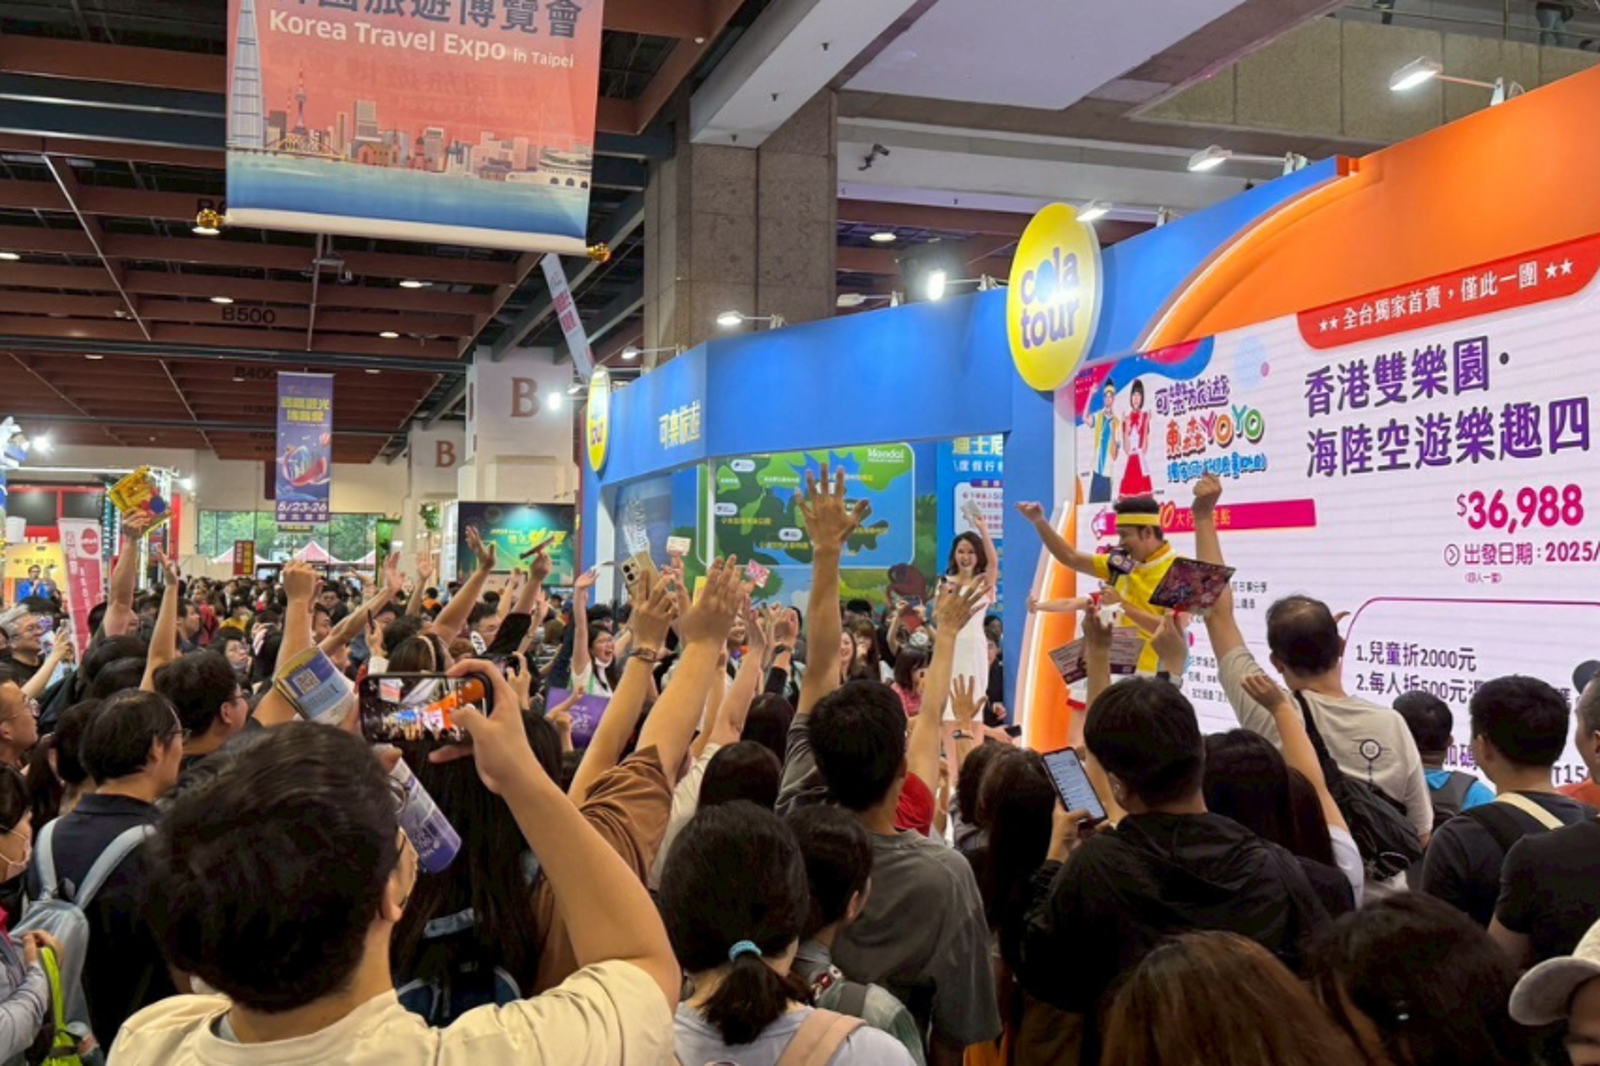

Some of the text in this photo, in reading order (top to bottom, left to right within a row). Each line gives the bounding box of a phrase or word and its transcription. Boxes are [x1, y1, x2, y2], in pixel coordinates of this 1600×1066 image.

[269, 8, 347, 40] Korea
[354, 22, 436, 51] Travel
[443, 33, 507, 61] Expo
[531, 51, 575, 69] Taipei
[299, 0, 582, 38] 遊博覽會
[1020, 246, 1080, 305] cola
[221, 306, 276, 325] B500
[1020, 299, 1079, 350] tour
[510, 376, 540, 418] B
[435, 439, 457, 468] B
[1456, 484, 1584, 534] $36,988
[1355, 640, 1477, 673] 1.兒童折2000元
